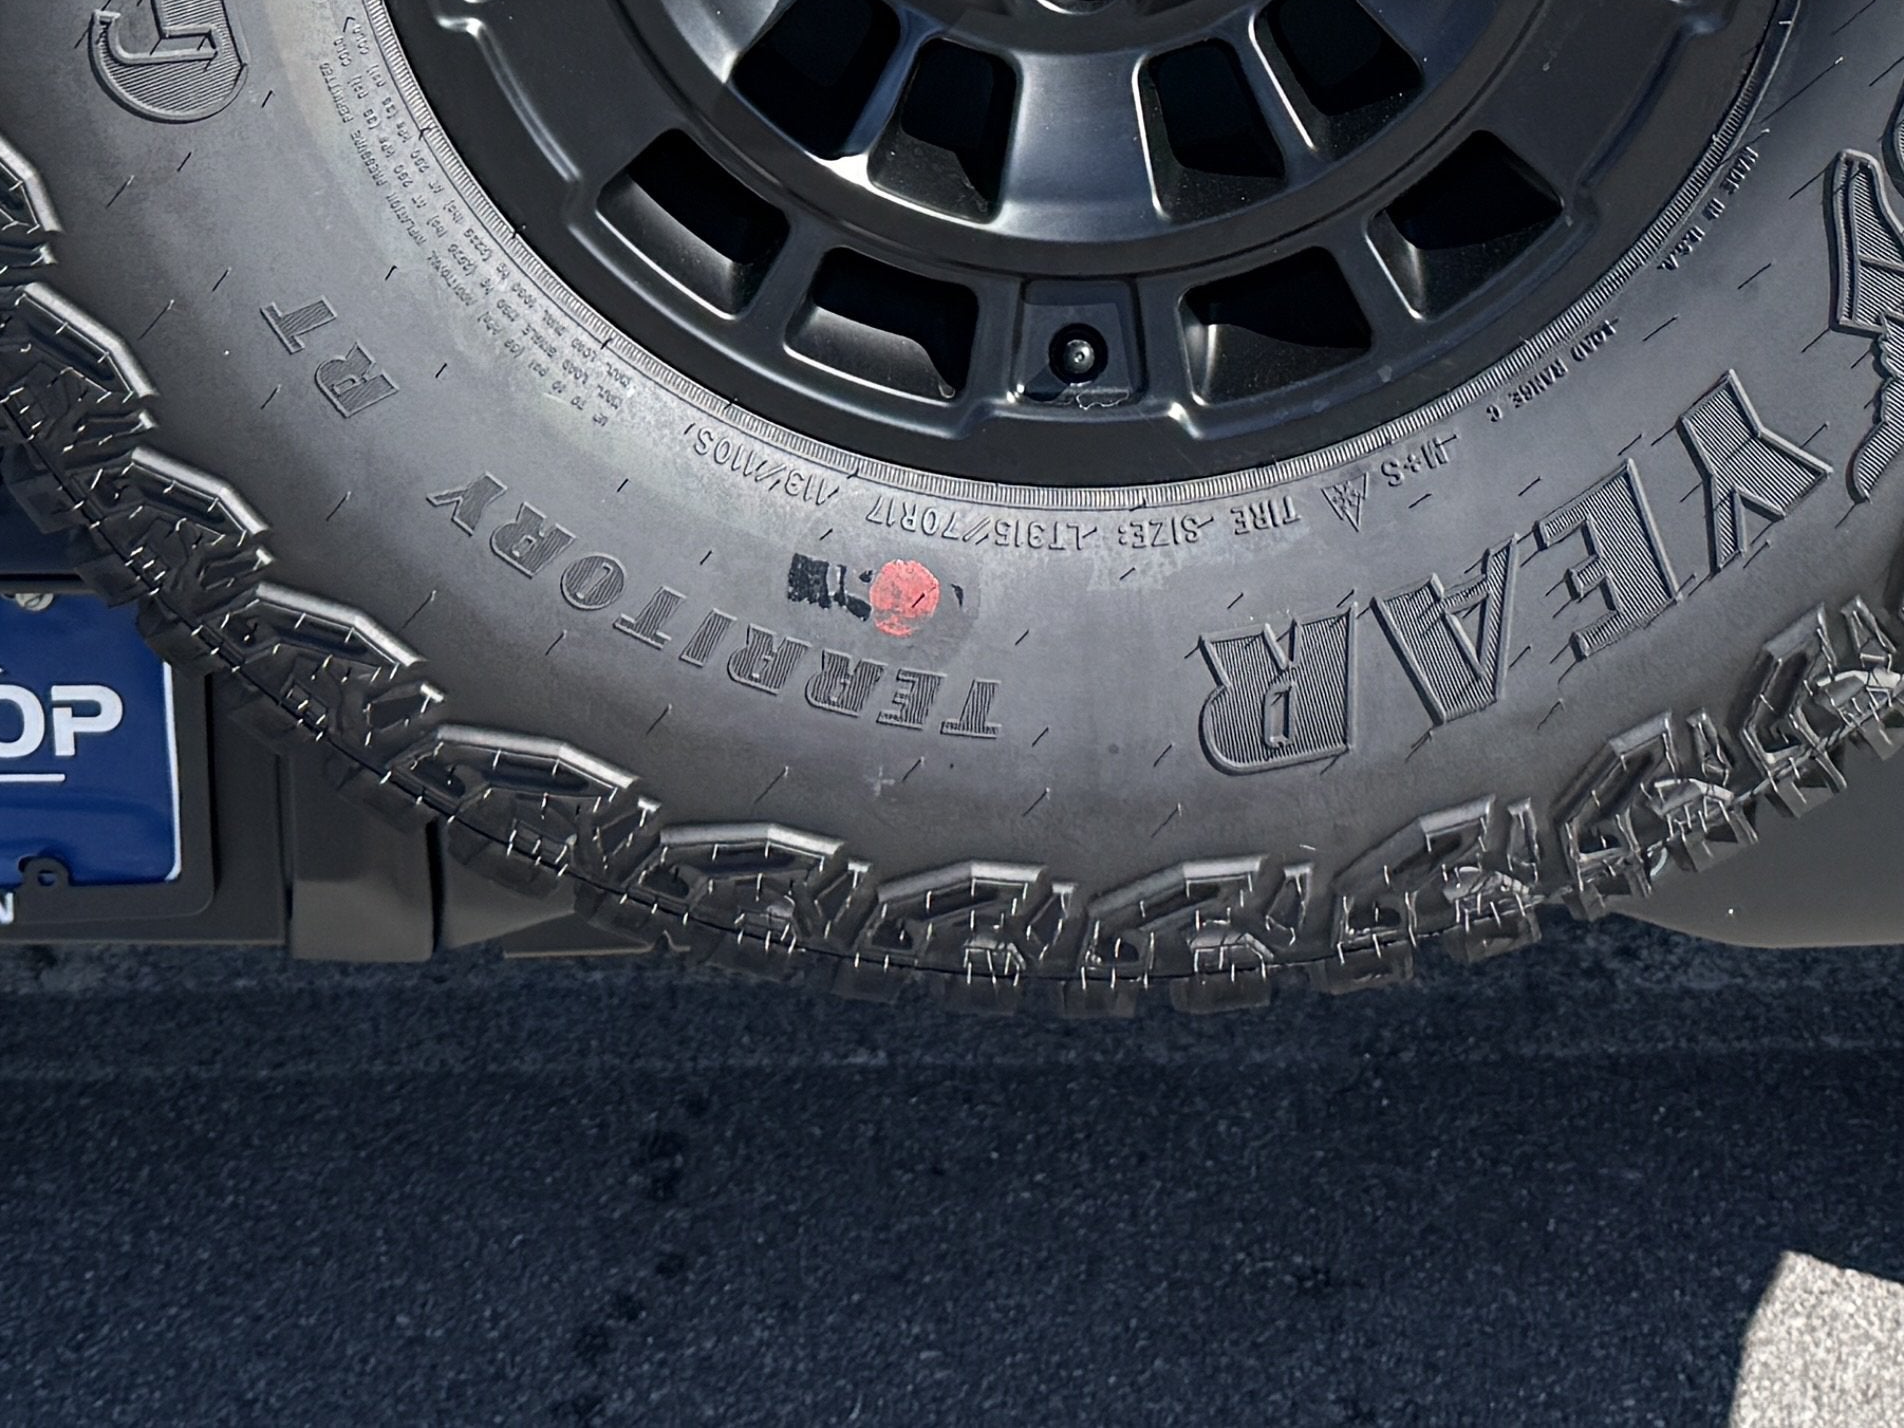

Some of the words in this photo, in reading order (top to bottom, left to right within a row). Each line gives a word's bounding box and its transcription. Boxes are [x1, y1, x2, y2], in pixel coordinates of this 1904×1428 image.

[260, 295, 401, 420] RT
[1505, 354, 1571, 412] RANGE
[1375, 434, 1451, 492] M+S
[863, 490, 1082, 553] LT315/70R17
[1115, 512, 1202, 552] SIZE:
[1227, 491, 1302, 538] TIRE
[425, 472, 1005, 740] TERRITORY
